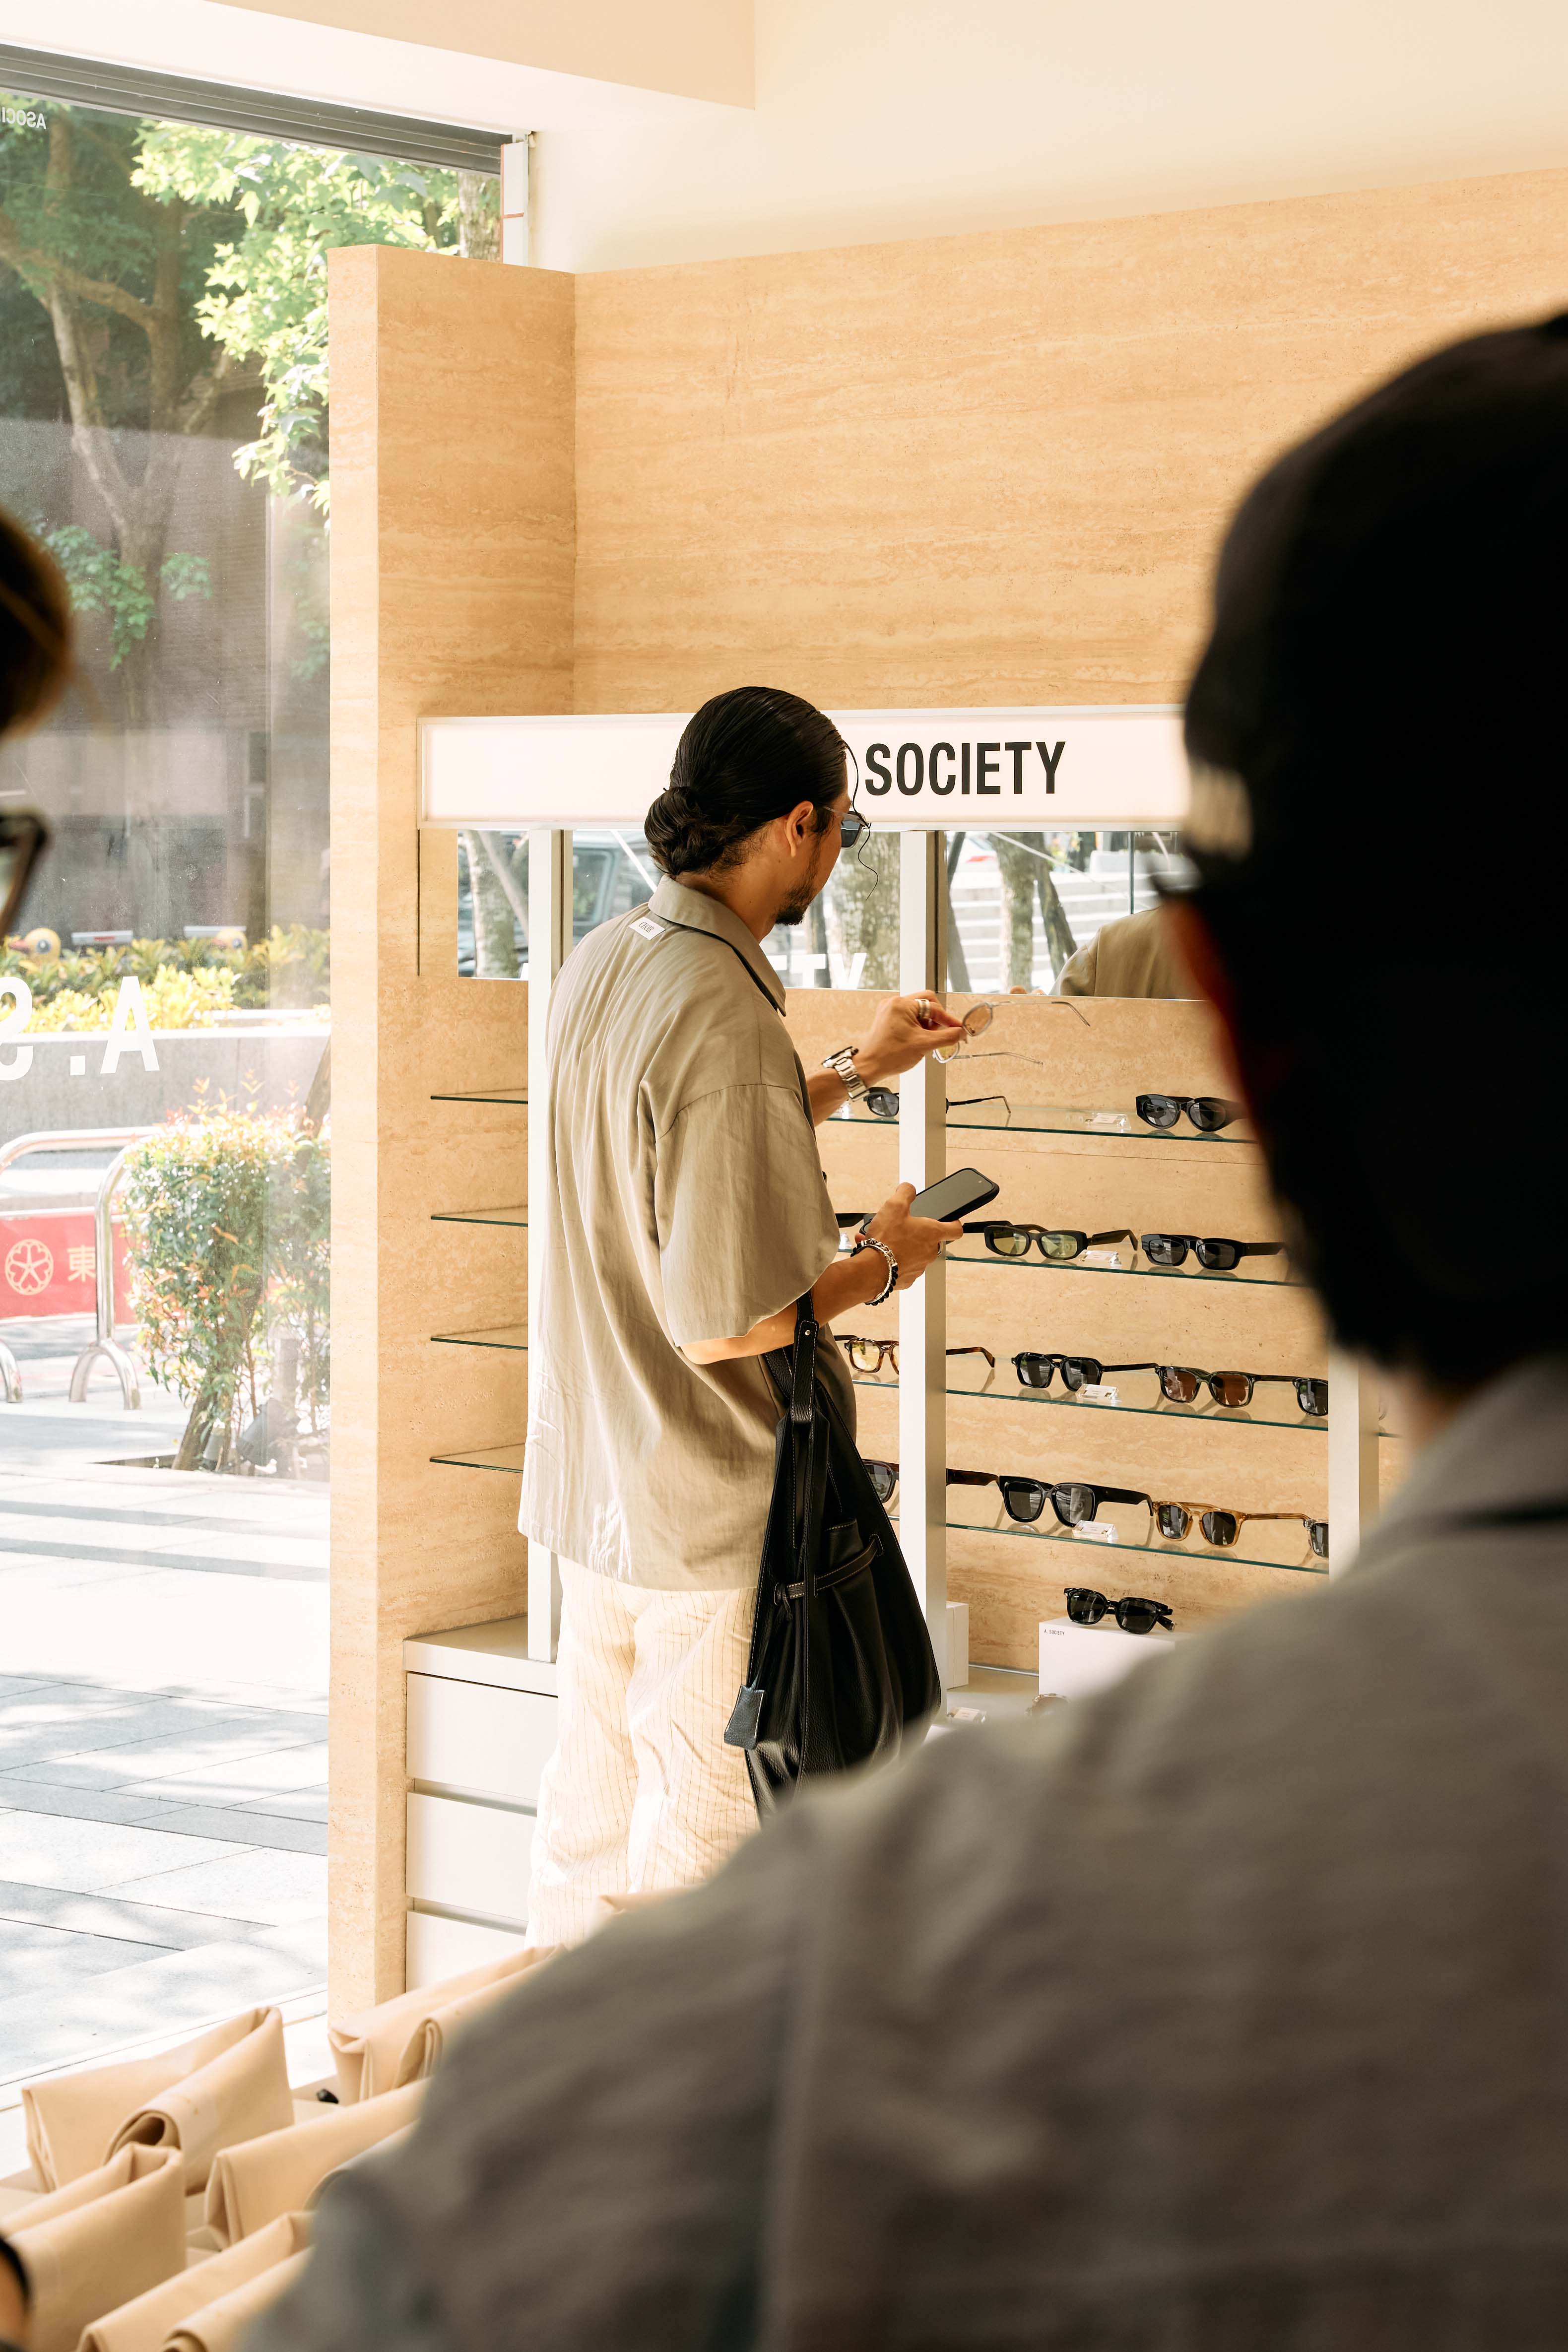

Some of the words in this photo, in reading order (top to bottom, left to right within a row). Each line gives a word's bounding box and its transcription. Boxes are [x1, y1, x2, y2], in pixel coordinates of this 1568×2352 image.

[865, 741, 1066, 796] SOCIETY
[639, 922, 654, 933] CHOIR
[67, 1244, 96, 1282] 東
